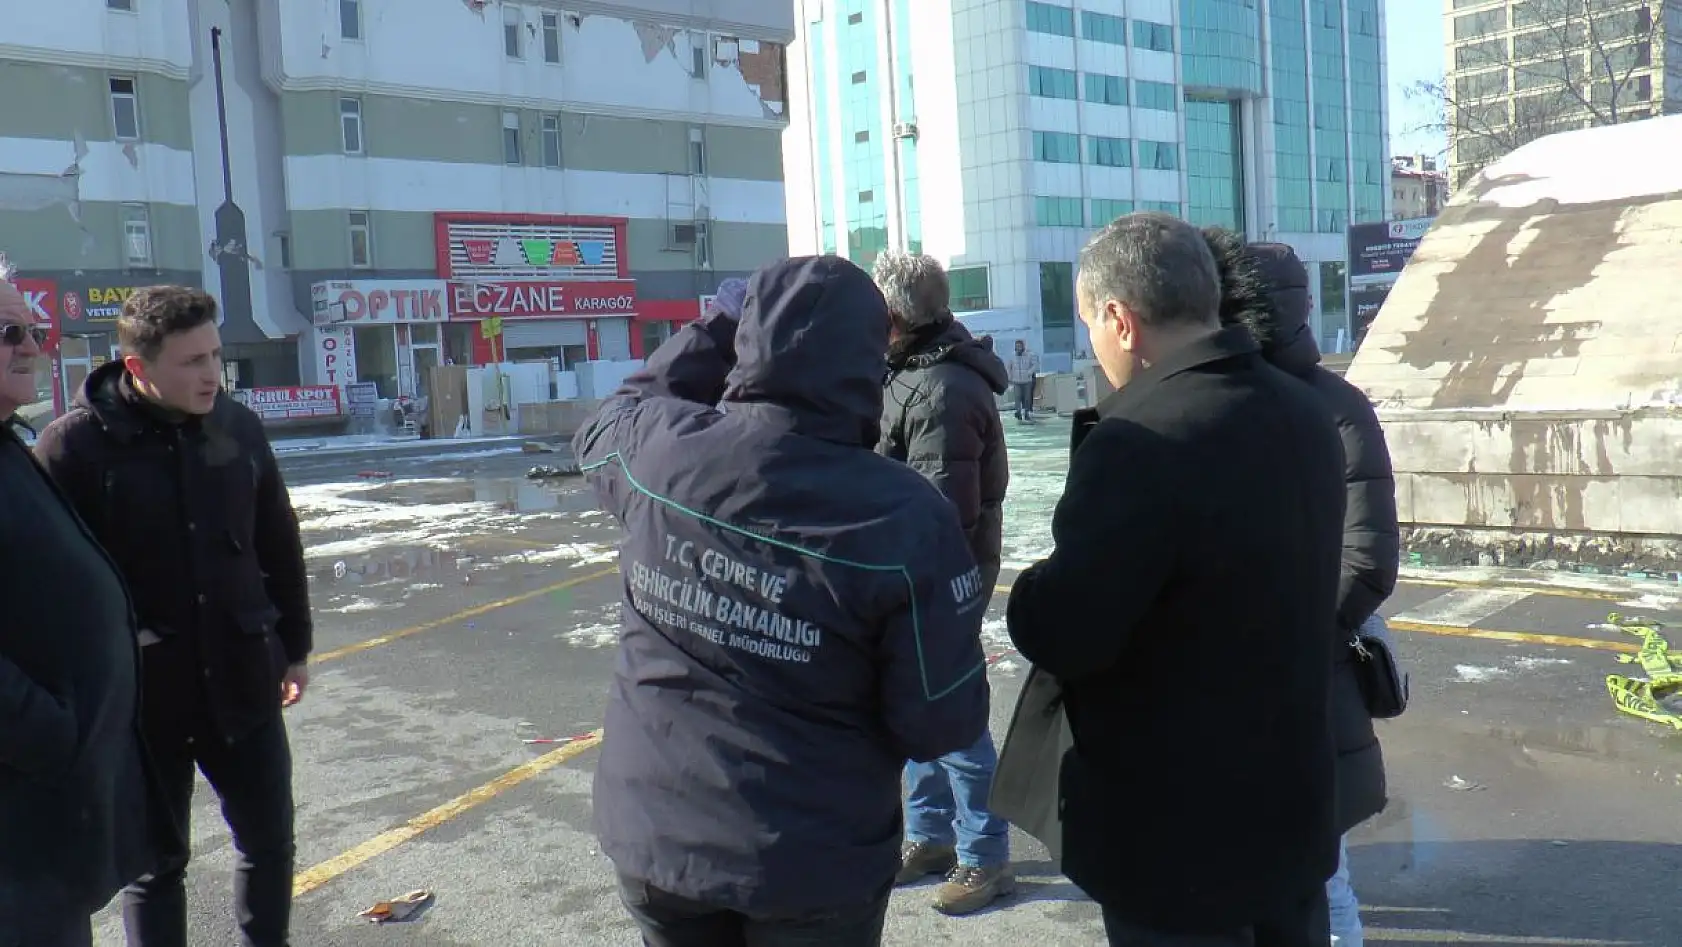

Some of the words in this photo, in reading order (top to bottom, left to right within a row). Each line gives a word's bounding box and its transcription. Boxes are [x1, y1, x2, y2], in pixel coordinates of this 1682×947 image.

[455, 286, 565, 313] ECZANE
[574, 296, 633, 310] KARAGÖZ
[700, 547, 758, 592] ÇEVRE
[761, 572, 787, 604] VE
[689, 621, 725, 646] GENEL
